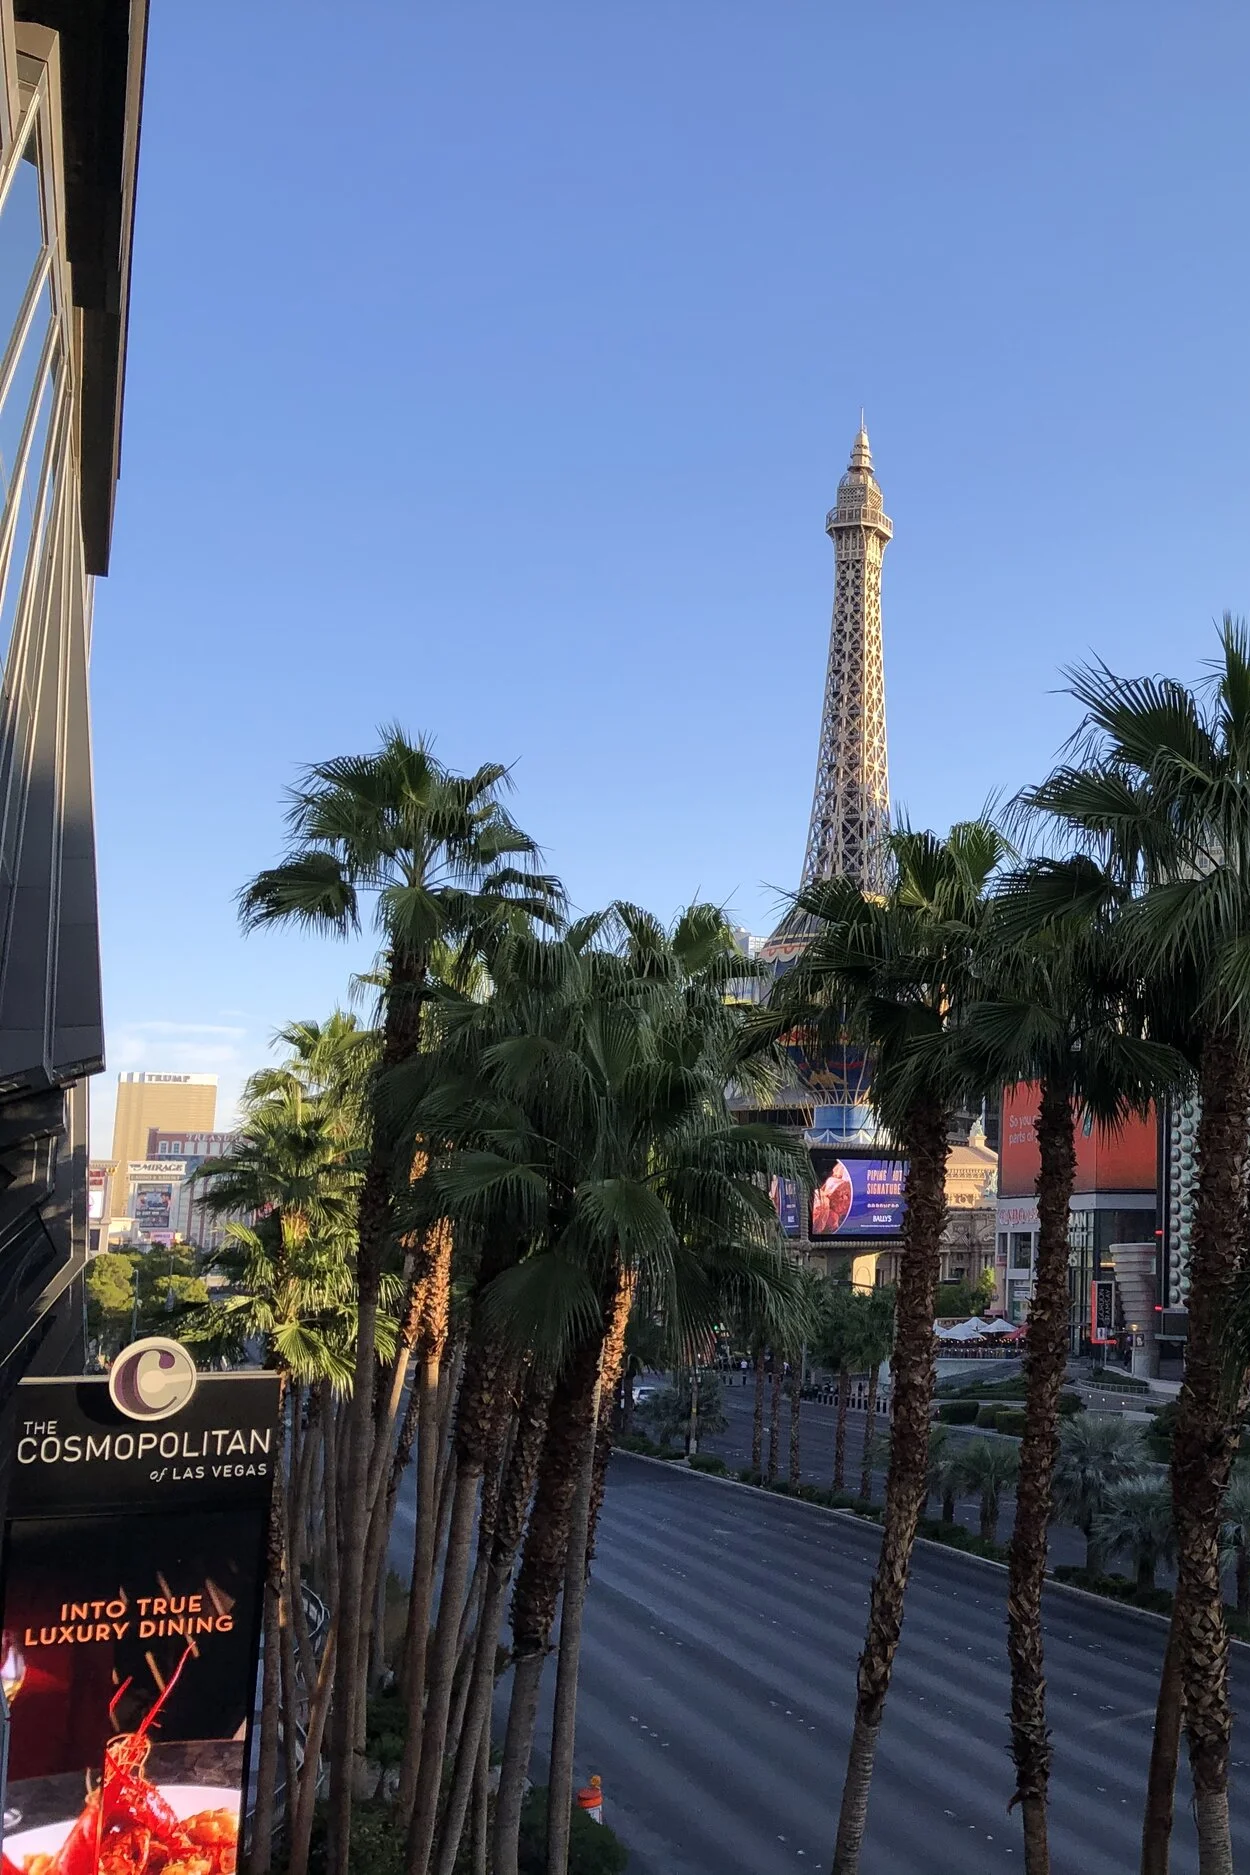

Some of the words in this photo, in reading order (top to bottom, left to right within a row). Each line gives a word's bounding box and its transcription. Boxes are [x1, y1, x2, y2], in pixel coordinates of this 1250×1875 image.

[147, 1074, 190, 1083] TRUMP
[139, 1164, 183, 1172] MIRAGE
[24, 1421, 58, 1435] THE
[17, 1429, 271, 1464] COSMOPOLITAN
[149, 1467, 168, 1482] of
[172, 1466, 205, 1480] LAS
[211, 1464, 267, 1478] VEGAS
[61, 1601, 126, 1622] INTO
[137, 1595, 202, 1617] TRUE
[24, 1622, 130, 1646] LUXURY
[140, 1614, 234, 1639] DINING
